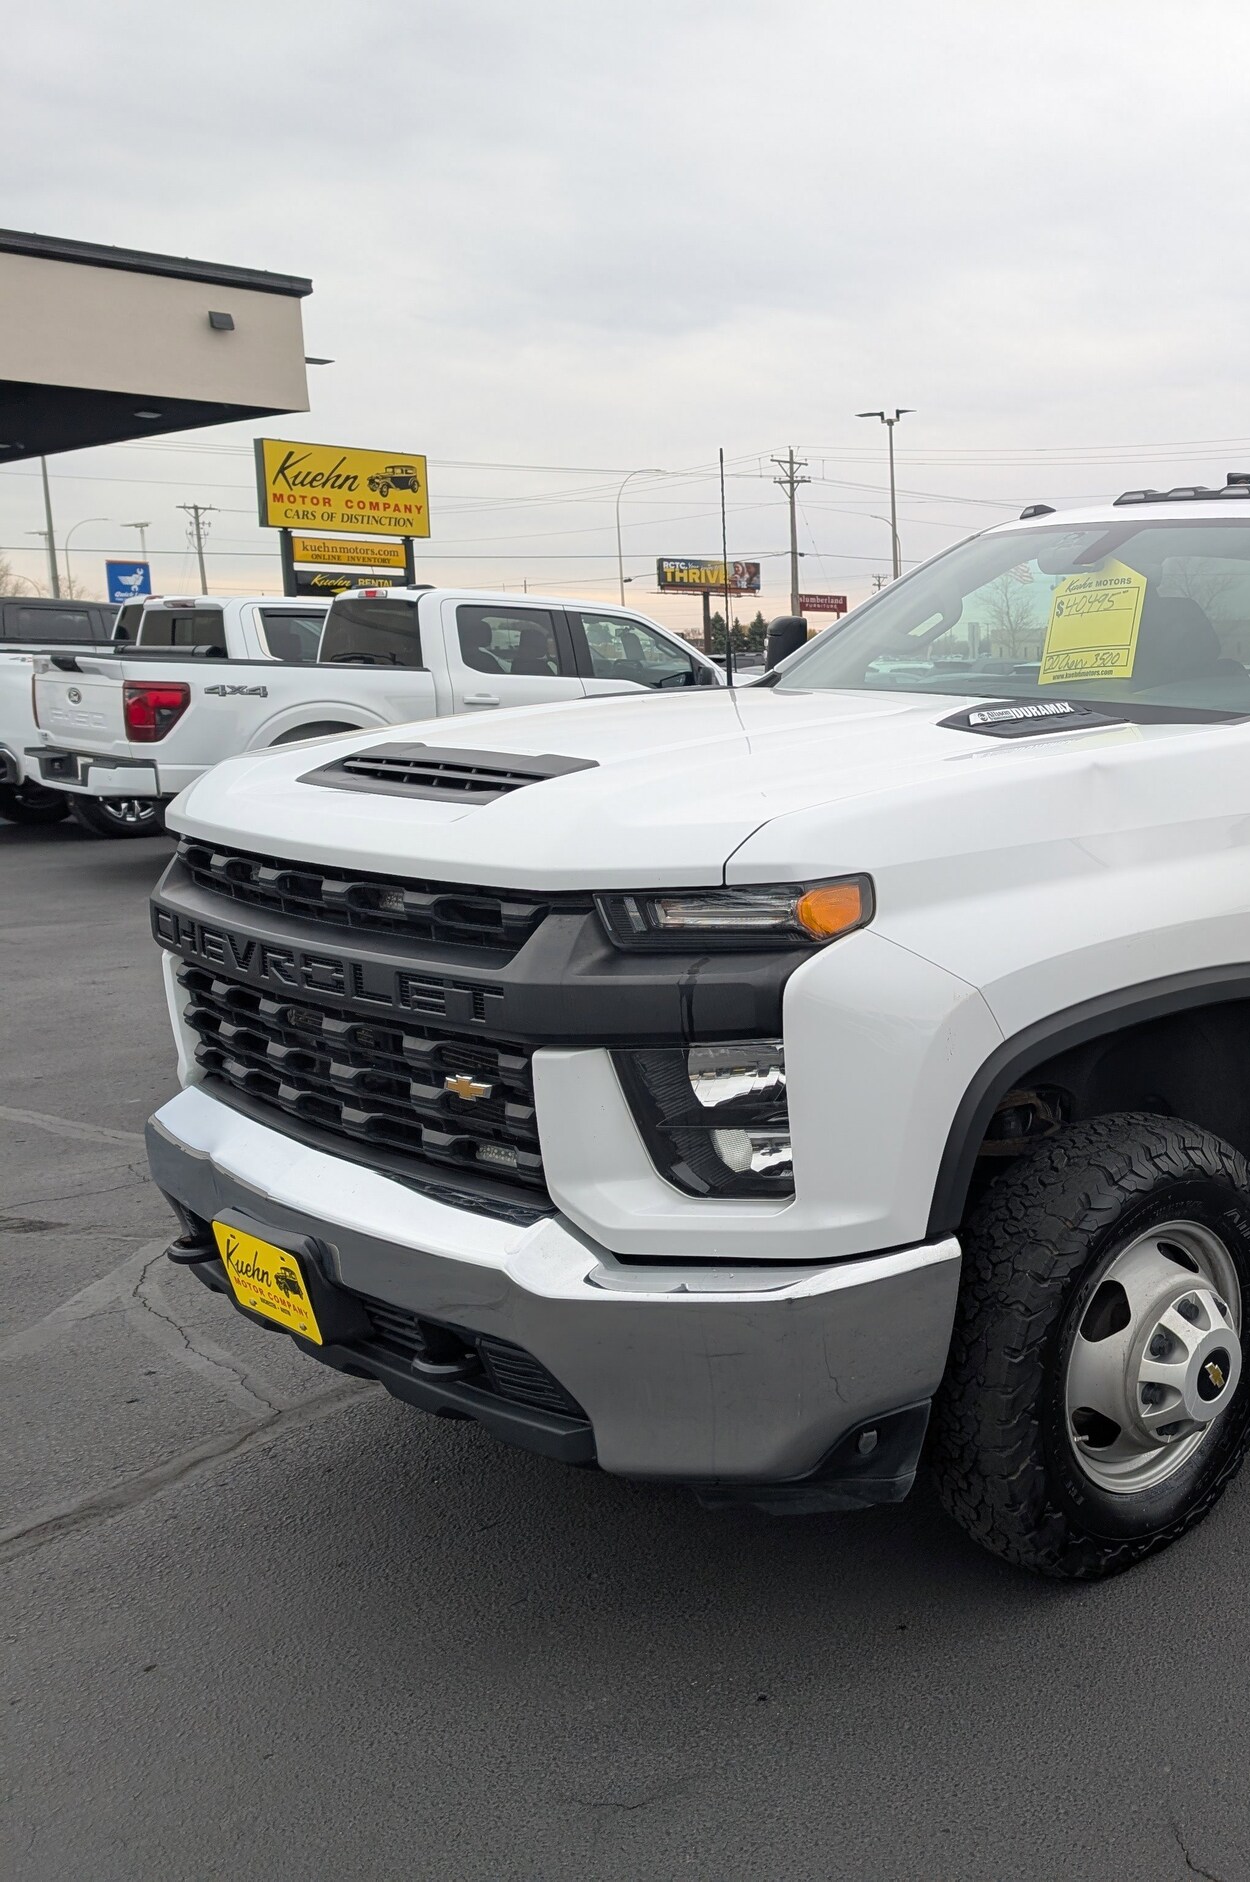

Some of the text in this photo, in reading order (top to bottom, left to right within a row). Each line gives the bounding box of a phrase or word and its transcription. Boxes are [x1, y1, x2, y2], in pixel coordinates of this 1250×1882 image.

[272, 450, 359, 492] Kuehn
[272, 493, 423, 515] MOTOR COMPANY
[284, 508, 414, 528] CARS OF DISTINCTION
[302, 541, 399, 557] kuehnmotors.com
[311, 553, 391, 565] ONLINE INVENTORY
[310, 573, 351, 587] Kuehn
[1065, 577, 1132, 593] Kuehn MOTORS
[1012, 702, 1074, 719] DURAMAX
[156, 907, 504, 1023] CHEVROLET
[226, 1238, 272, 1288] Kuehn
[234, 1276, 266, 1297] MOTOR
[267, 1291, 309, 1319] COMPANY
